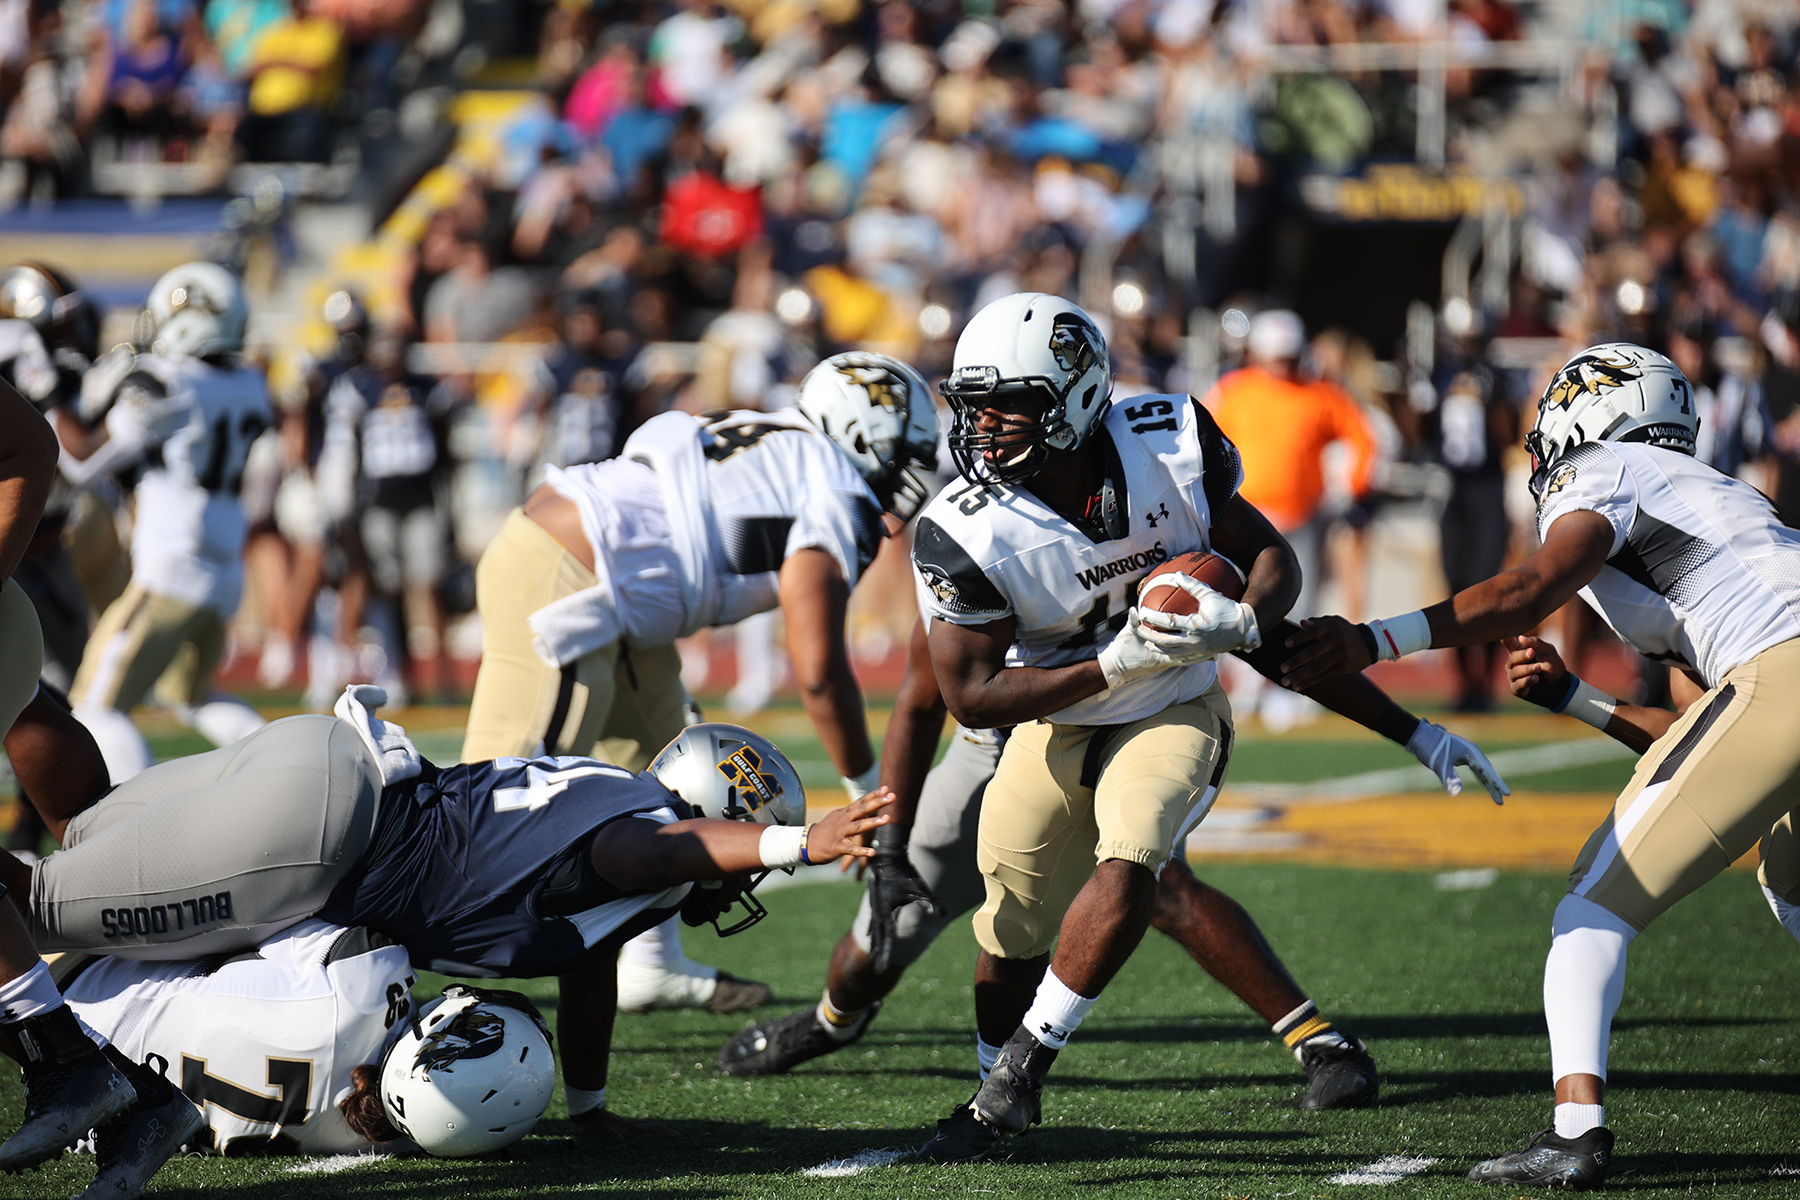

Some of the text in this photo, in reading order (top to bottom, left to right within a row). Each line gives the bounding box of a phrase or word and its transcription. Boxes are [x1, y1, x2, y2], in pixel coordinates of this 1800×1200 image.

[1124, 400, 1178, 435] 15
[1671, 378, 1690, 415] 7
[946, 484, 1006, 517] 15
[1074, 540, 1168, 591] WARRIORS
[733, 755, 770, 799] GULF COAST
[101, 891, 232, 938] BULLDOGS
[179, 1051, 314, 1156] 7
